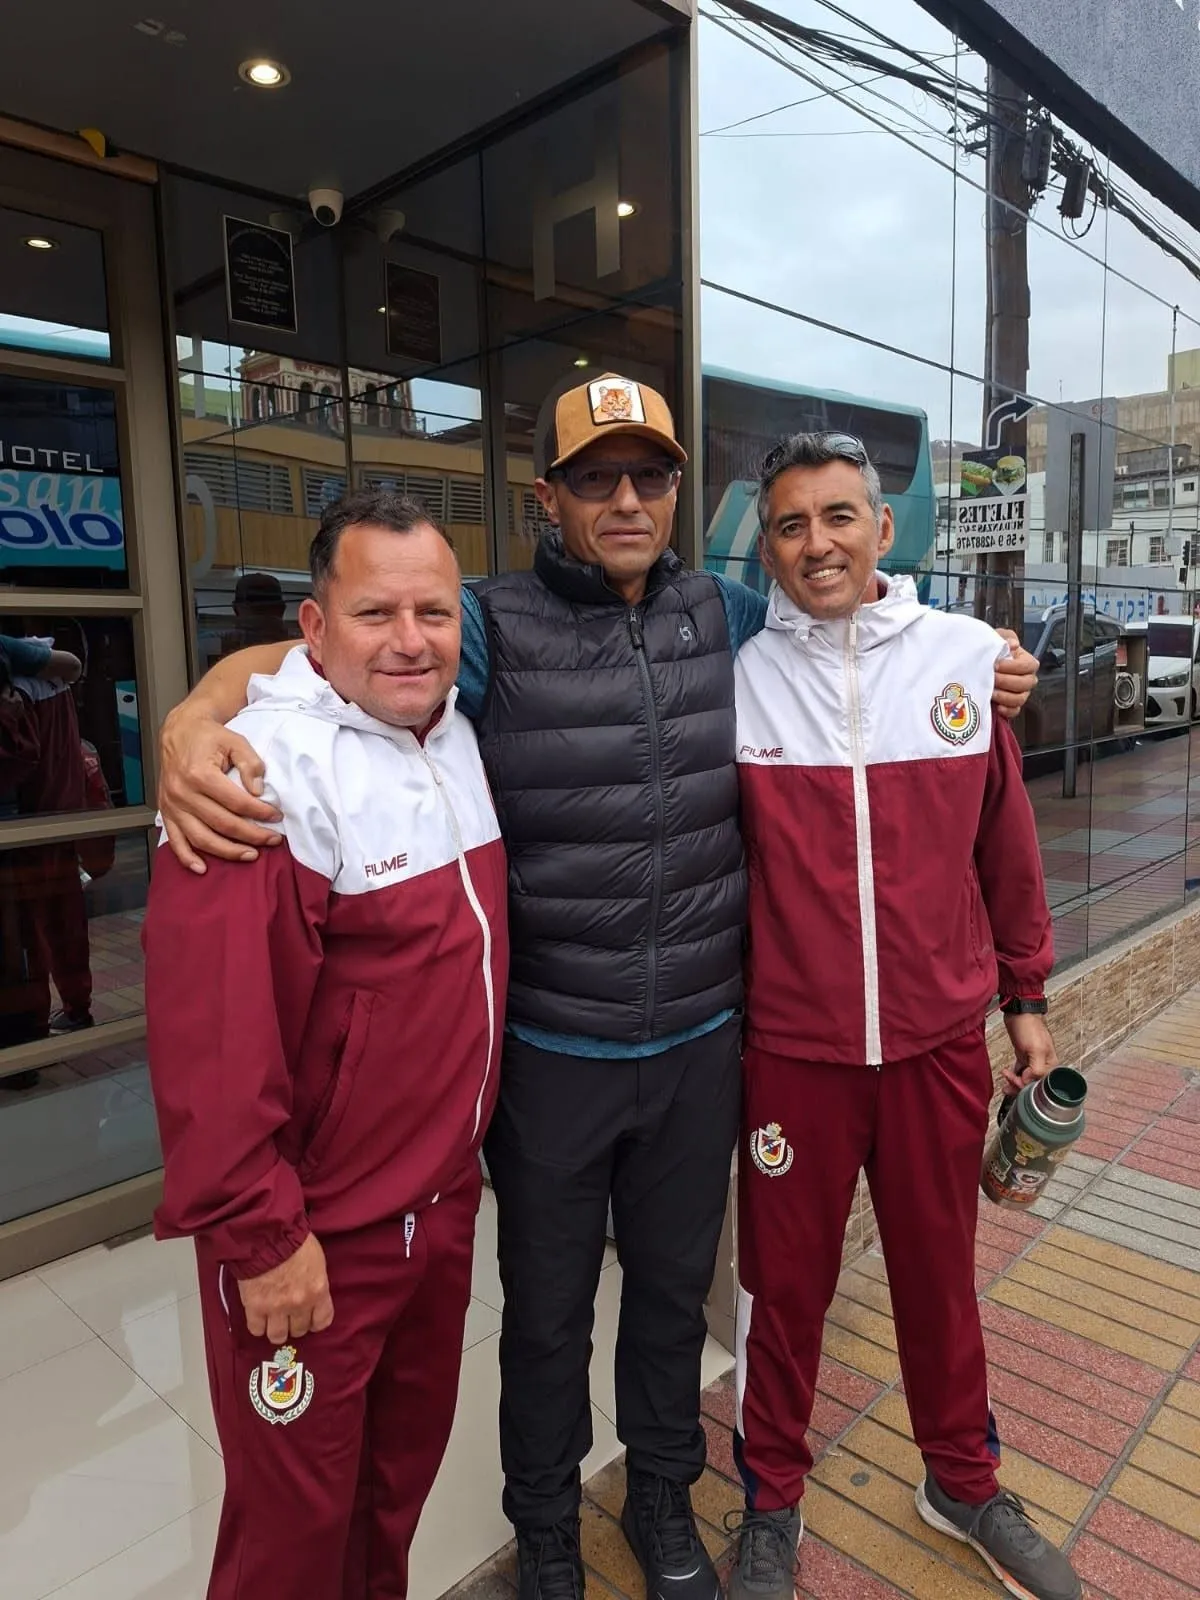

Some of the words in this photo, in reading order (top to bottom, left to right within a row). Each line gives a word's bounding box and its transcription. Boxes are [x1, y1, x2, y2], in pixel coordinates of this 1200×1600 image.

[0, 440, 104, 473] OTEL
[0, 468, 106, 513] san
[739, 745, 783, 758] FIUME
[364, 852, 408, 878] FIUME
